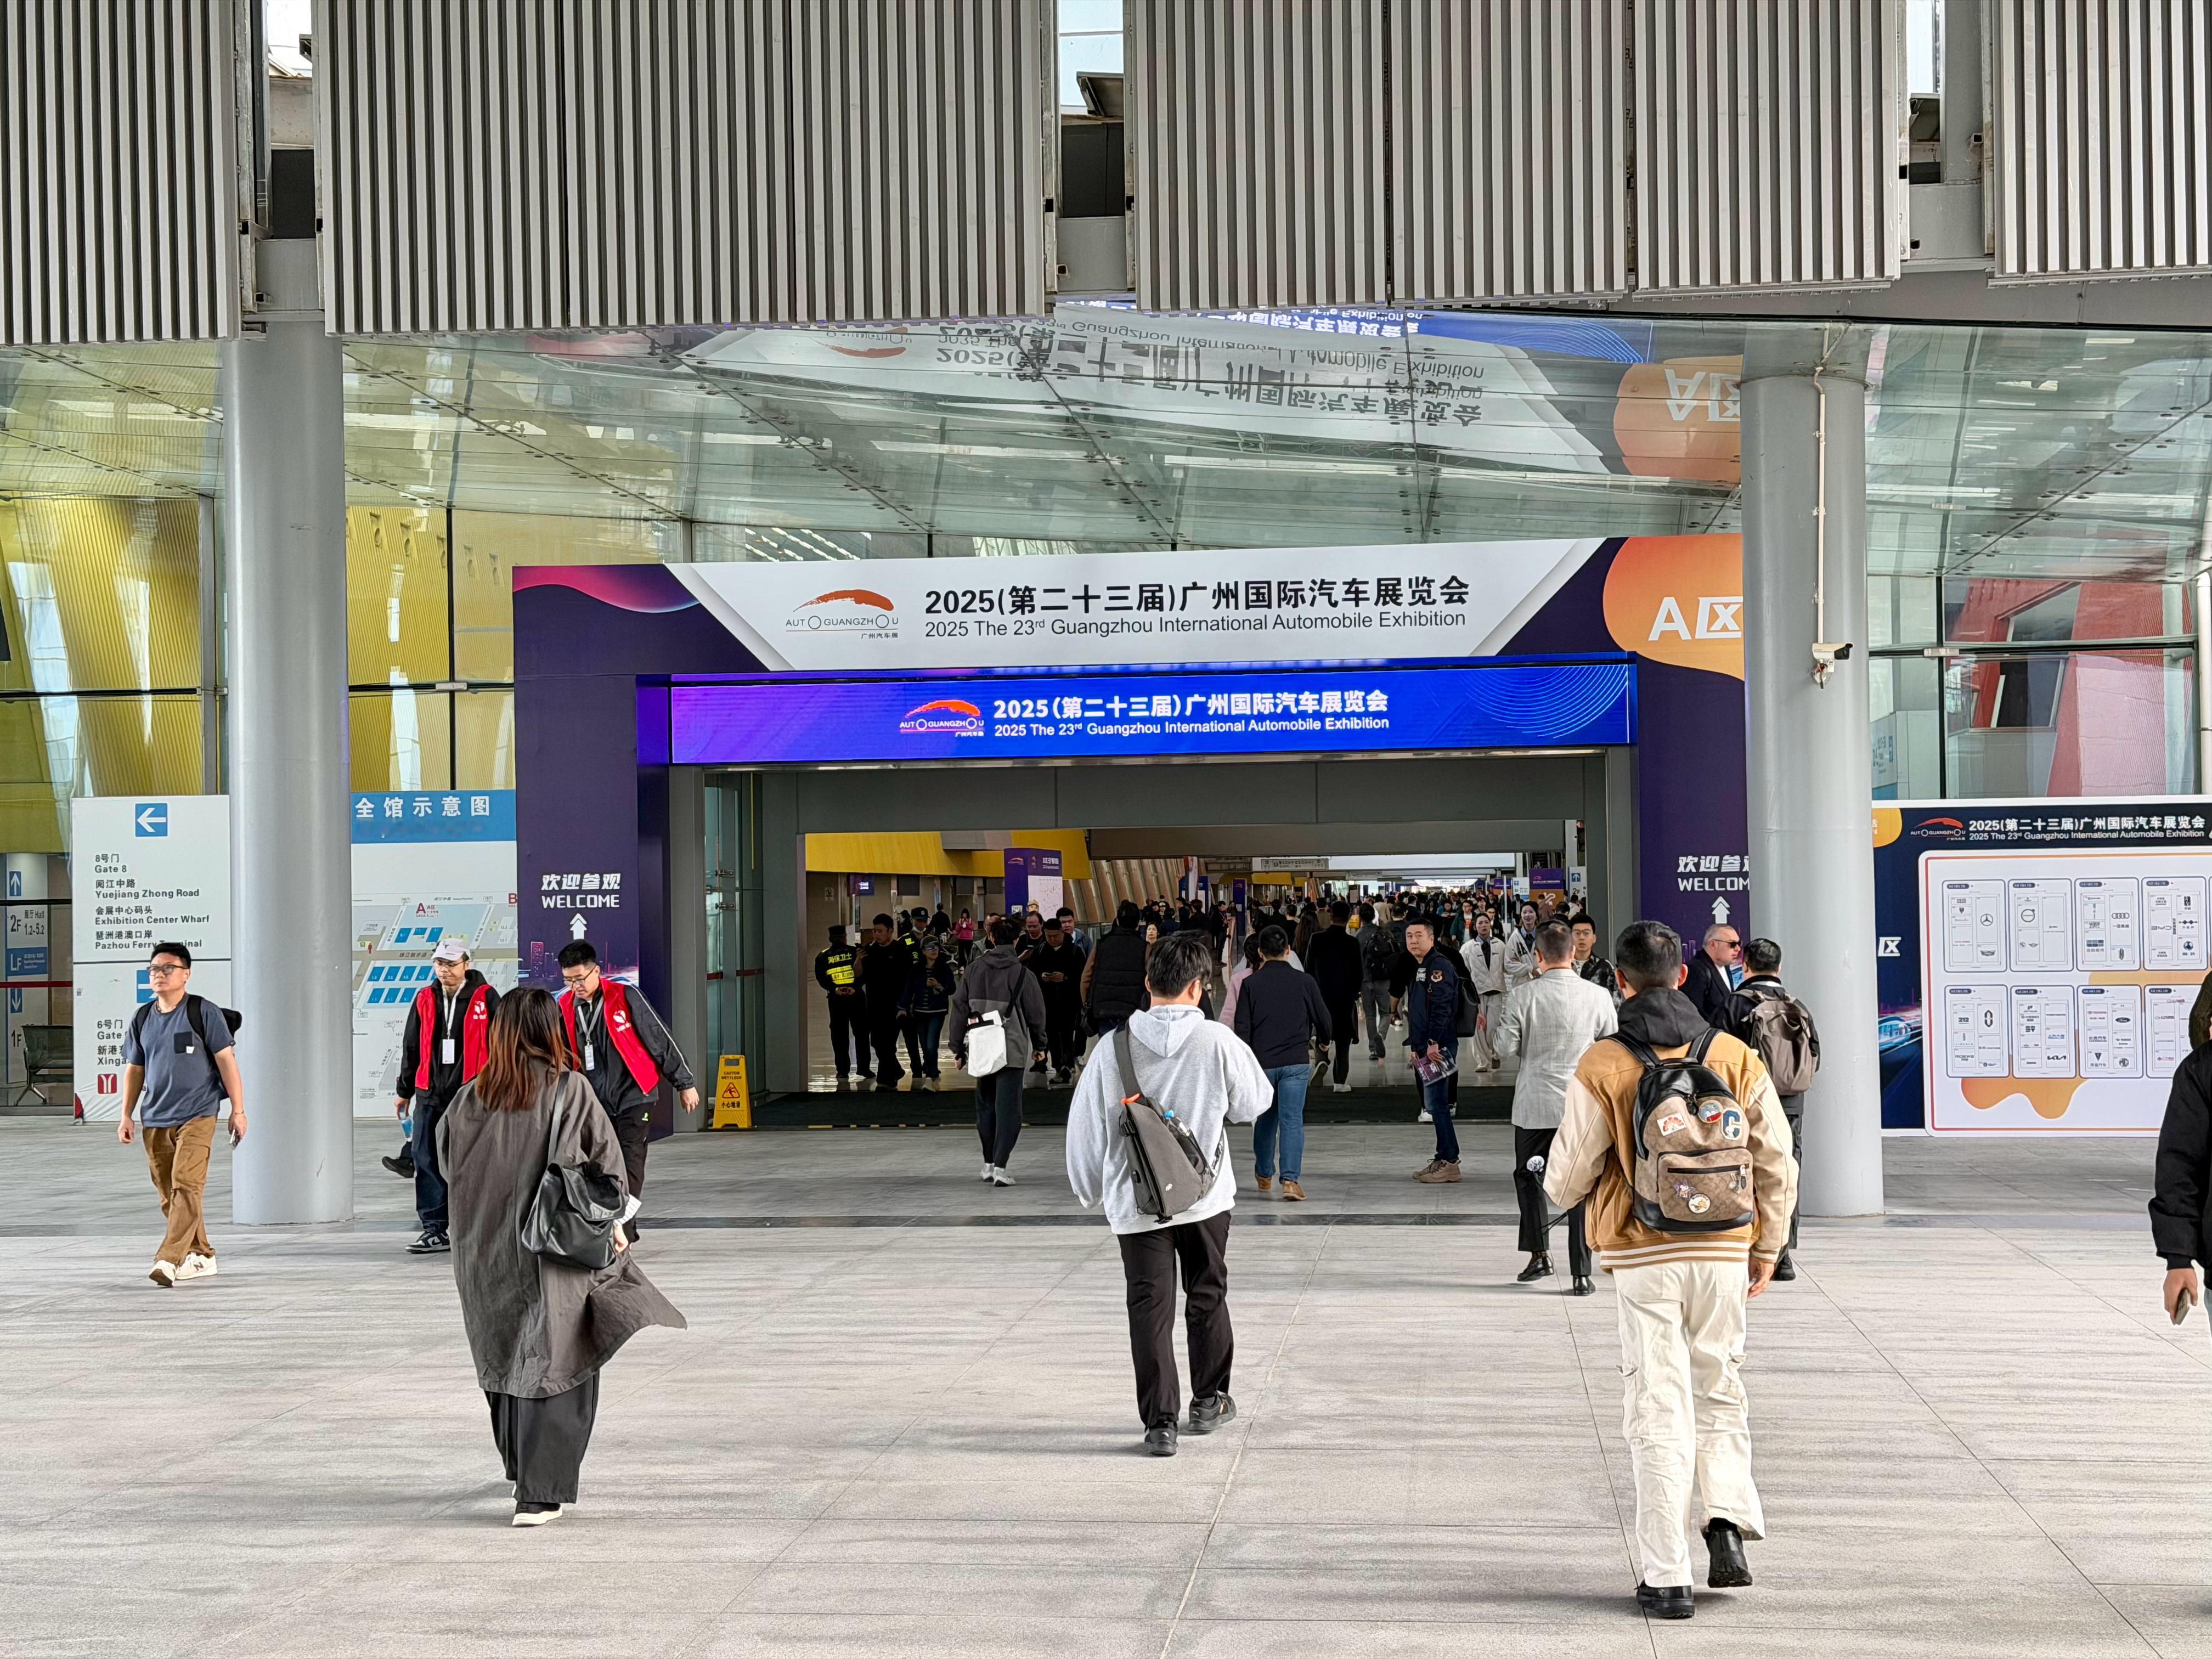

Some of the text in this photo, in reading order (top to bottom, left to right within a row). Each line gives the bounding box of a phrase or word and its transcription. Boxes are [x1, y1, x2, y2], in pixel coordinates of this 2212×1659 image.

[925, 575, 1470, 616] 2025(第二十三届)广州国际汽车展览会
[925, 610, 1466, 637] 2025 The 23rd Guangzhou International Automobile Exhibition
[993, 689, 1389, 719] 2025(第二十三届)广州国际汽车展览会
[995, 716, 1389, 737] 2025 The 23rd Guangzhou International Automobile Exhibition
[354, 795, 490, 819] 全馆示意图
[1968, 815, 2205, 832] 2025(第二十三届)广州国际汽车展览会
[2008, 832, 2022, 840] 23rd
[2024, 831, 2069, 841] Guangzhou
[2071, 830, 2119, 839] International
[2120, 830, 2164, 838] Automobile
[2166, 830, 2204, 838] Exhibition
[95, 854, 120, 863] 8号门
[94, 865, 127, 873] Gate 8
[95, 878, 136, 888] 阅江中路
[541, 873, 621, 890] 欢迎参观
[1678, 877, 1750, 891] WELCOM
[95, 888, 200, 900] Yuejiang Zhong Road
[541, 894, 620, 909] WELCOME
[95, 905, 153, 915] 会展中心码头
[95, 915, 210, 925] Exhibition Center Wharf
[95, 941, 130, 950] Pazhou
[132, 940, 157, 949] Ferry
[97, 1019, 123, 1029] 6号门
[97, 1031, 122, 1040] Gate
